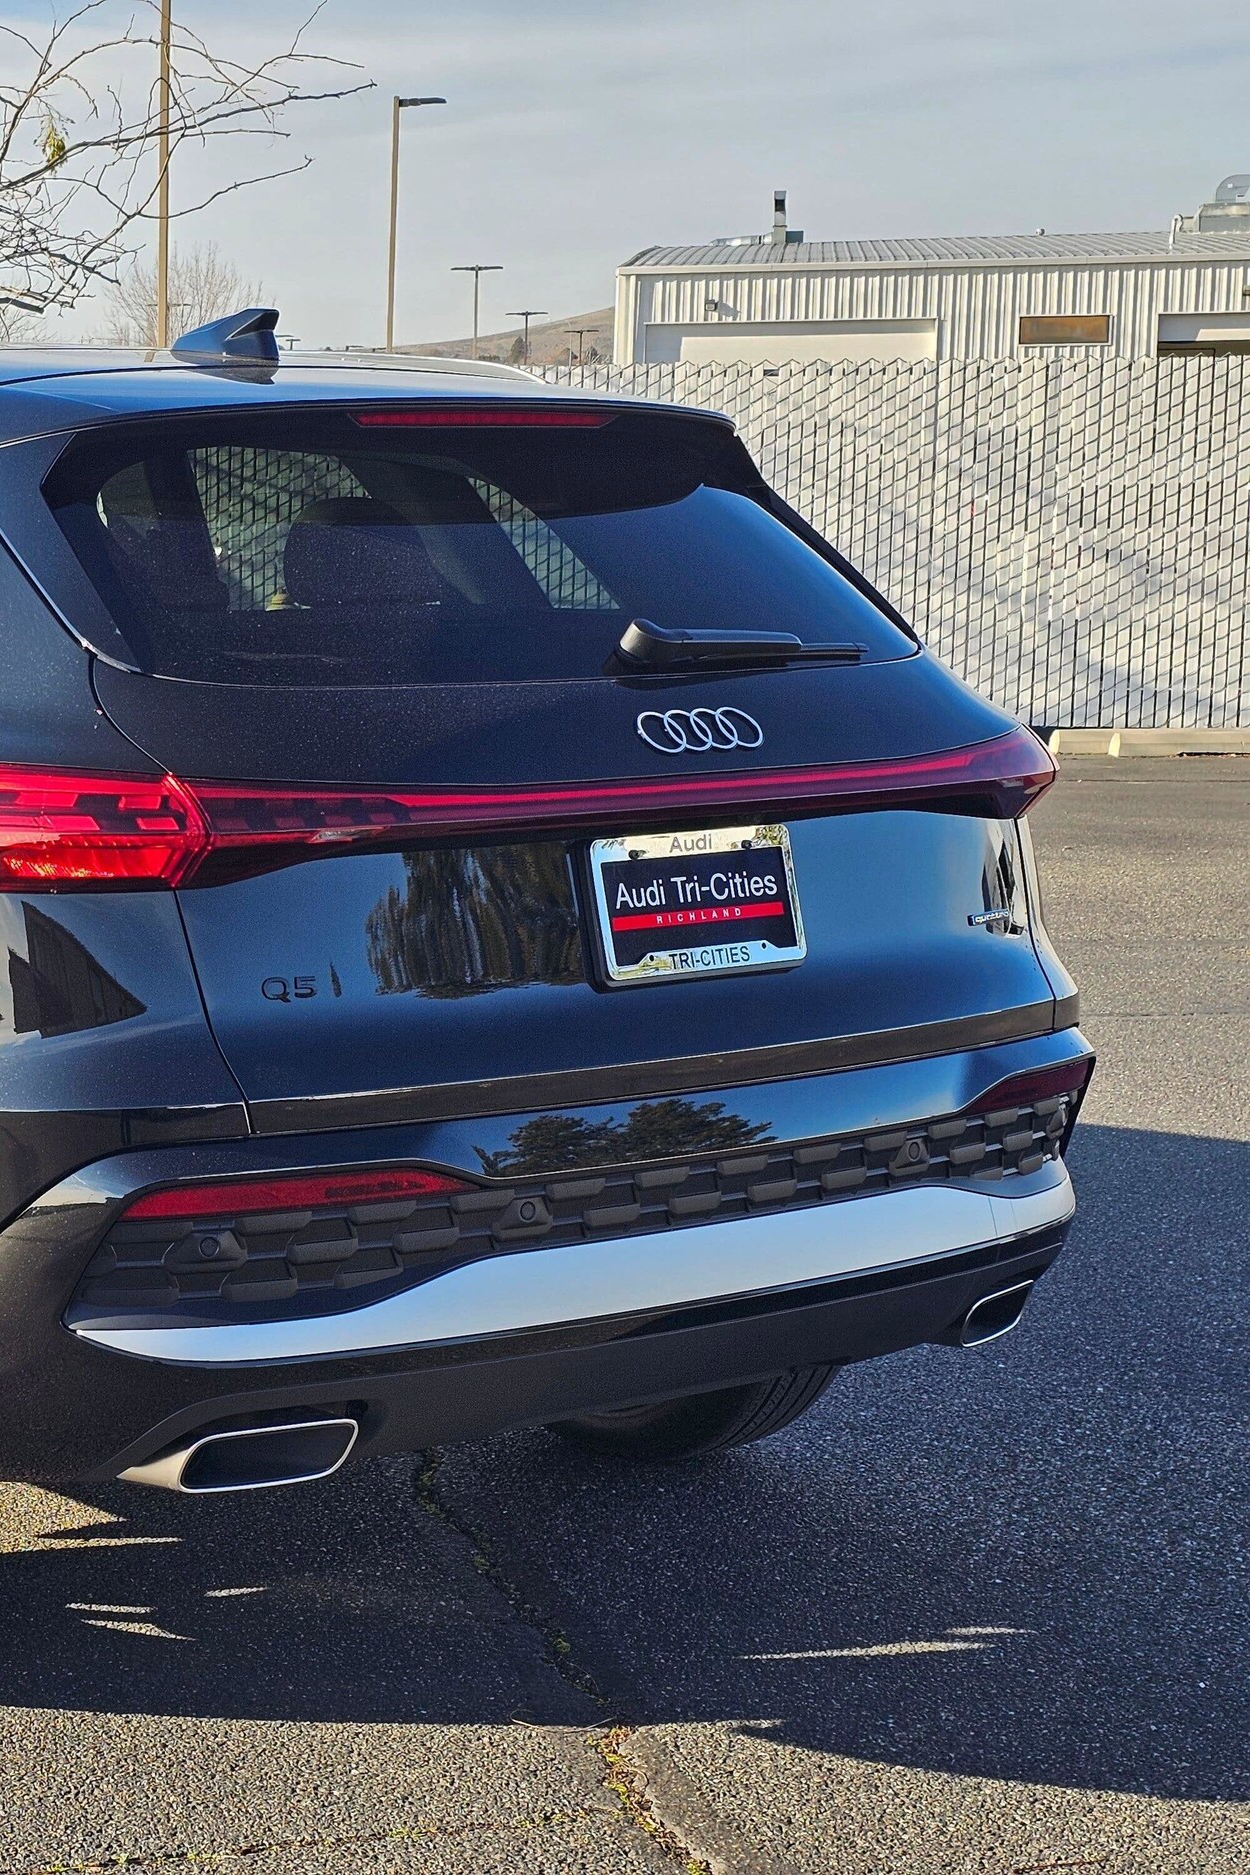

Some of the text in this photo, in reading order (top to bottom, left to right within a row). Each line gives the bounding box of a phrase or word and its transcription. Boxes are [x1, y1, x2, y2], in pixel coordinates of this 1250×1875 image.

[669, 833, 712, 853] Audi
[615, 870, 778, 909] Audi Tri-Cities
[656, 907, 742, 924] RICHLAND
[974, 910, 1010, 924] quattro
[669, 945, 751, 970] TRI-CITIES
[261, 975, 317, 1003] Q5
